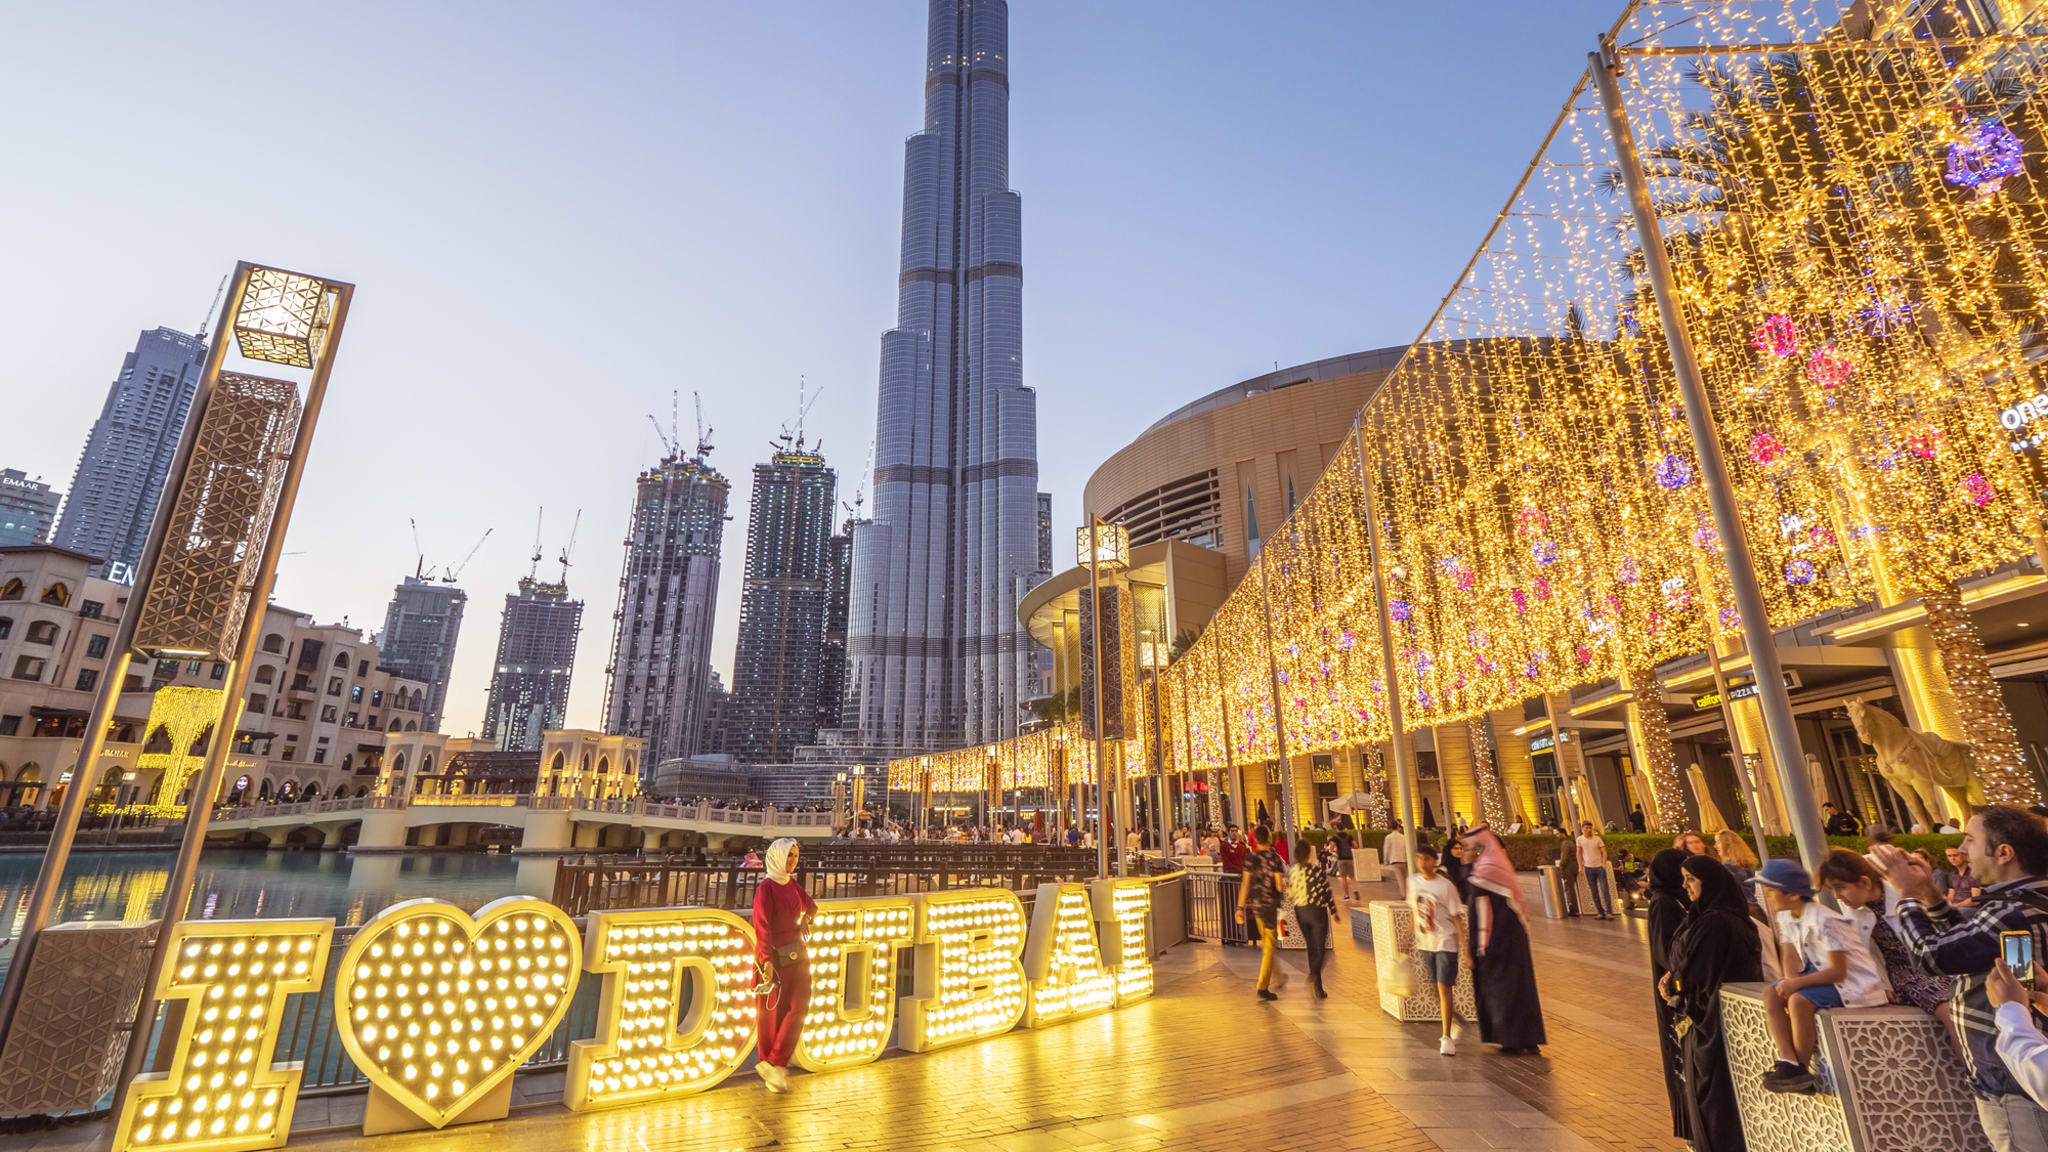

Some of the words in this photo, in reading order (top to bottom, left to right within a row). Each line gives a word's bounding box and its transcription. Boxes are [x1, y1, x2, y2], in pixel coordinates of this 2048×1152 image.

[3, 477, 39, 491] EMAAR
[1696, 693, 1731, 708] californ
[1730, 687, 1752, 699] PIZZA
[112, 918, 336, 1152] I
[565, 876, 1156, 1111] DUBAI
